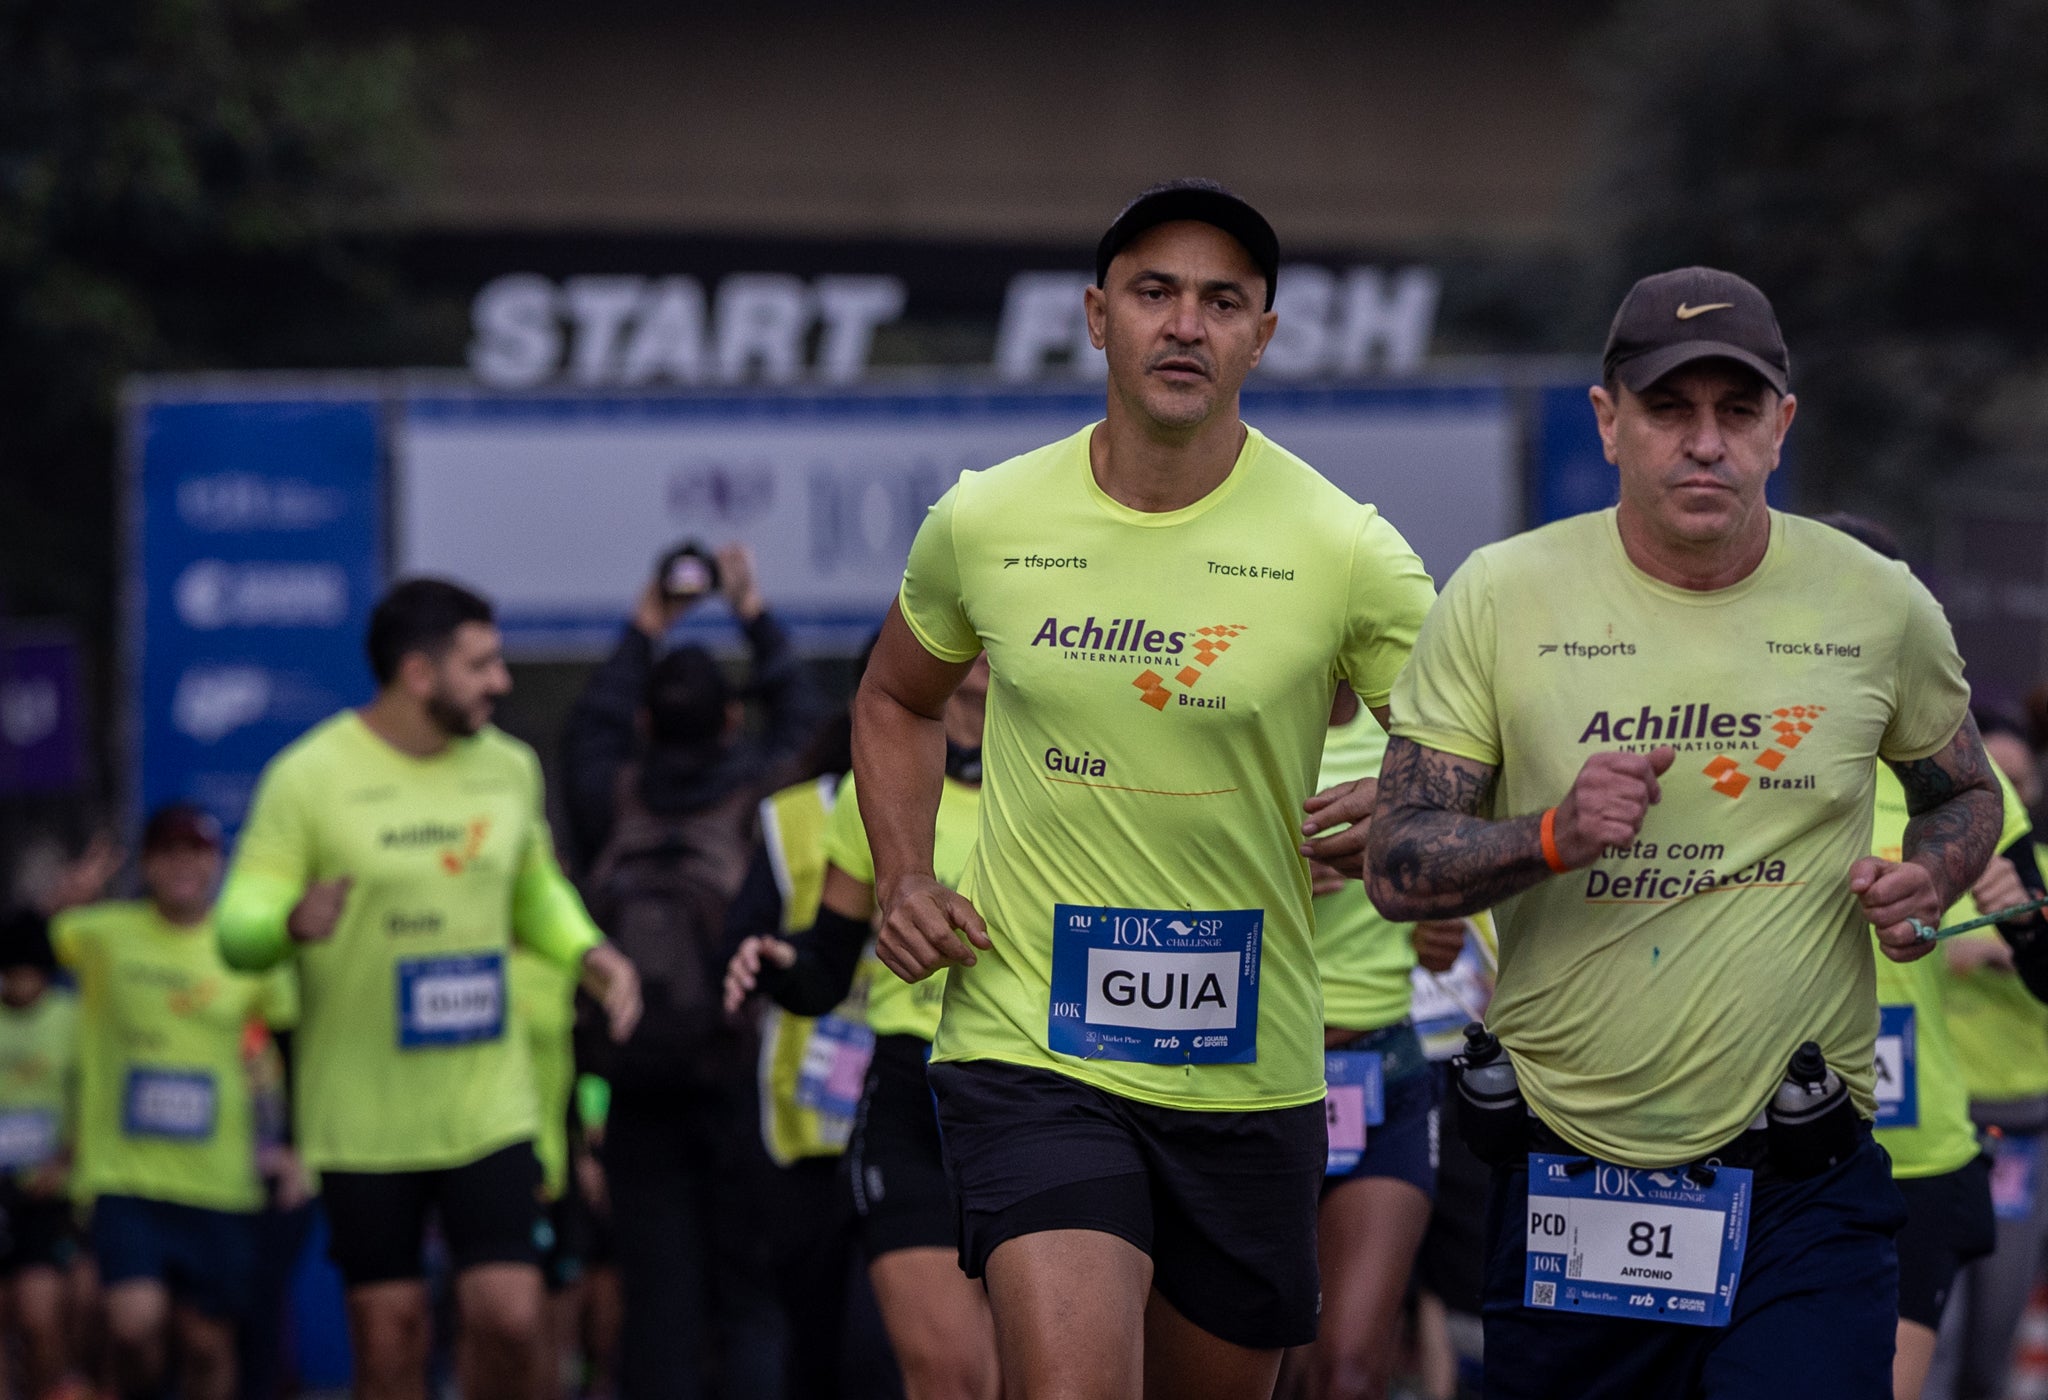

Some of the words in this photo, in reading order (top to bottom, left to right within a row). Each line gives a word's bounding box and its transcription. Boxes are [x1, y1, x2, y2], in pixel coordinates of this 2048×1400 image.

[467, 272, 905, 387] START
[1024, 555, 1087, 569] tfsports
[1031, 616, 1187, 655] Achilles
[1064, 651, 1180, 667] INTERNATIONAL
[1563, 642, 1636, 659] tfsports
[1179, 694, 1226, 709] Brazil
[1578, 703, 1762, 743] Achilles
[1045, 748, 1107, 777] Guia
[1759, 775, 1816, 789] Brazil
[1667, 843, 1725, 860] com
[1069, 915, 1092, 928] nu
[1112, 916, 1164, 947] 10K
[1198, 919, 1223, 937] SP
[1166, 938, 1223, 947] CHALLENGE
[1101, 970, 1228, 1010] GUIA
[1053, 1001, 1081, 1018] 10K
[1154, 1035, 1181, 1048] rvb
[1594, 1164, 1645, 1197] 10K
[1648, 1190, 1706, 1203] CHALLENGE
[1531, 1212, 1566, 1236] PCD
[1628, 1221, 1674, 1259] 81
[1533, 1255, 1561, 1274] 10K
[1620, 1266, 1673, 1281] ANTONIO
[1629, 1292, 1655, 1307] rvb
